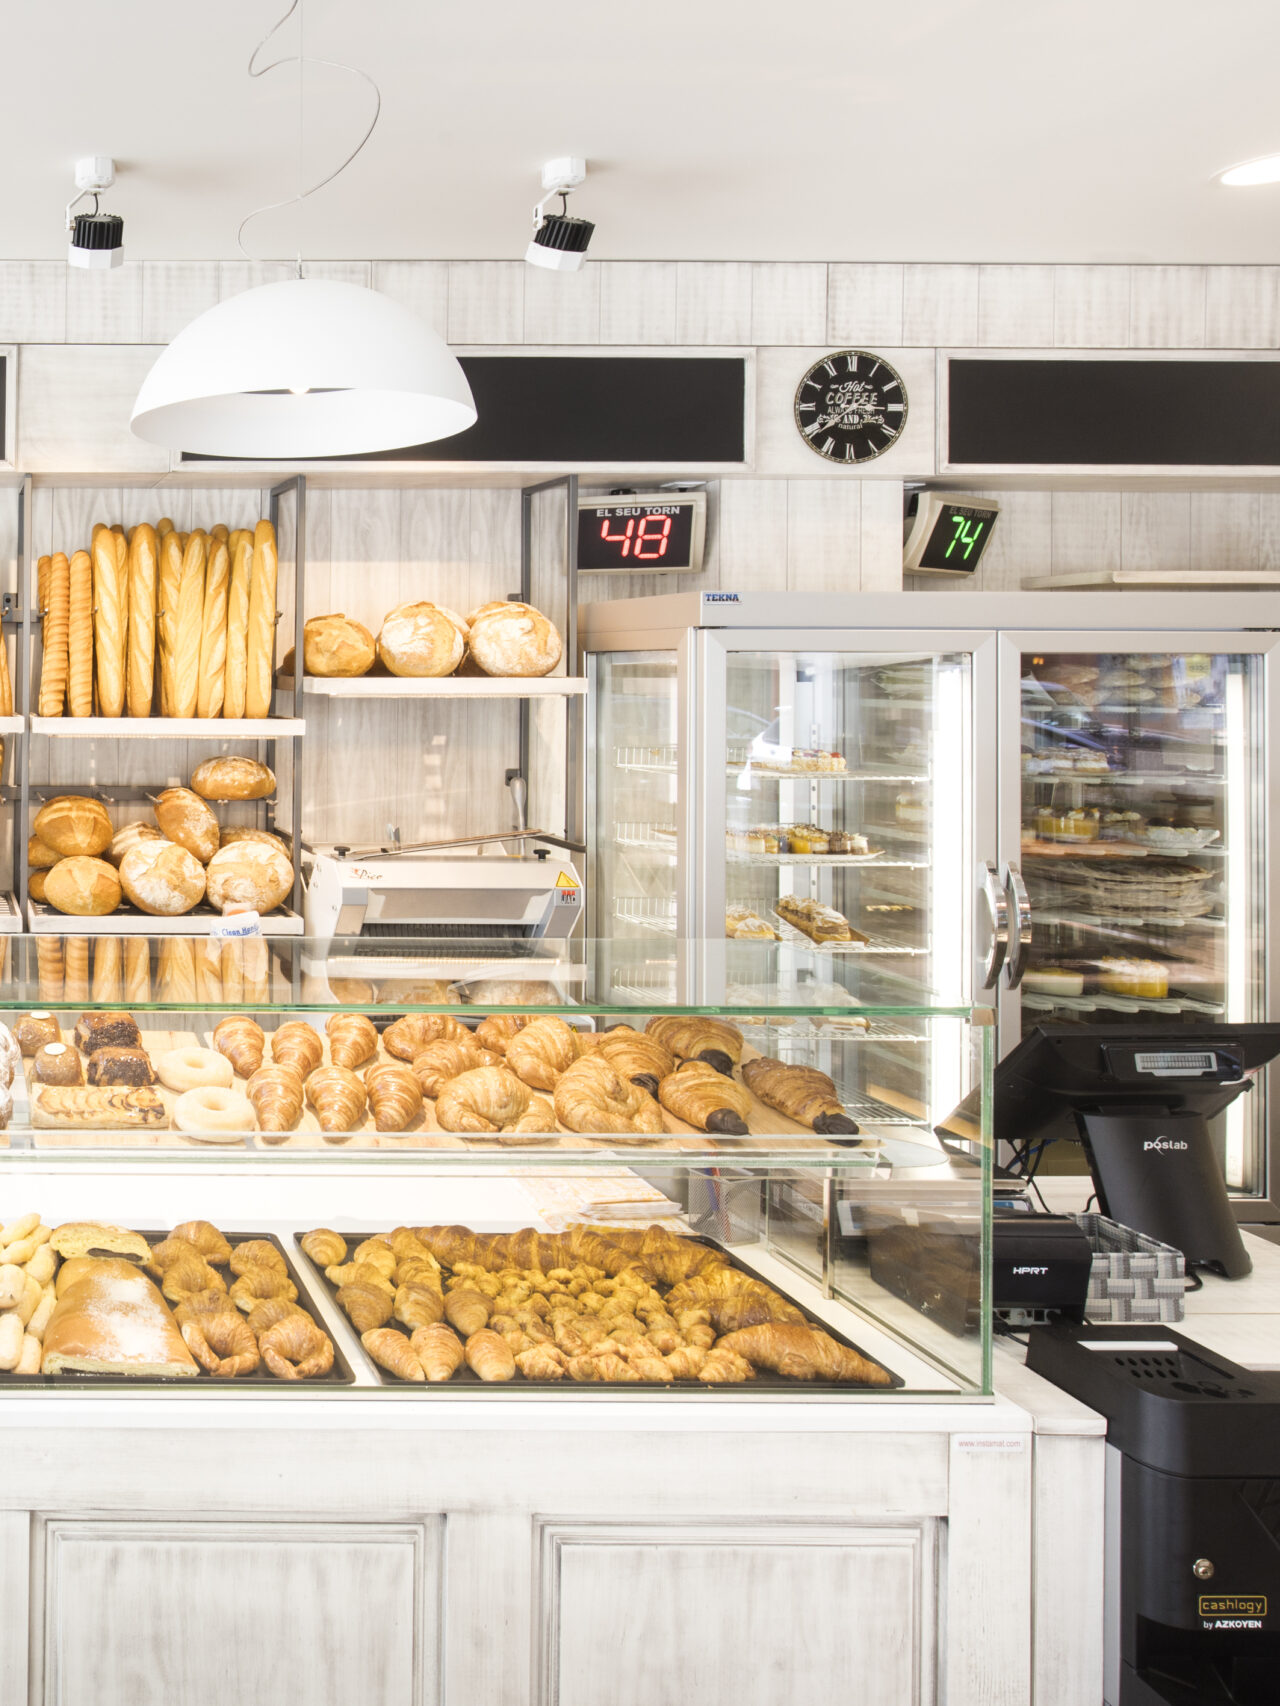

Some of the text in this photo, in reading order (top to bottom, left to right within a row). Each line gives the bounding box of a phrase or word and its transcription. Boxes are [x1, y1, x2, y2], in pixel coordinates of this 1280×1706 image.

[839, 381, 865, 392] Hot
[825, 392, 878, 405] COFFEE
[842, 414, 860, 424] AND
[596, 506, 680, 517] EL SEU TORN
[600, 514, 672, 559] 48
[945, 515, 984, 560] 74
[705, 593, 739, 602] TEKNA
[1143, 1138, 1188, 1152] poslab
[1013, 1266, 1049, 1275] HPRT
[1202, 1599, 1262, 1613] cashlogy
[1203, 1620, 1262, 1630] by AZKOYEN
